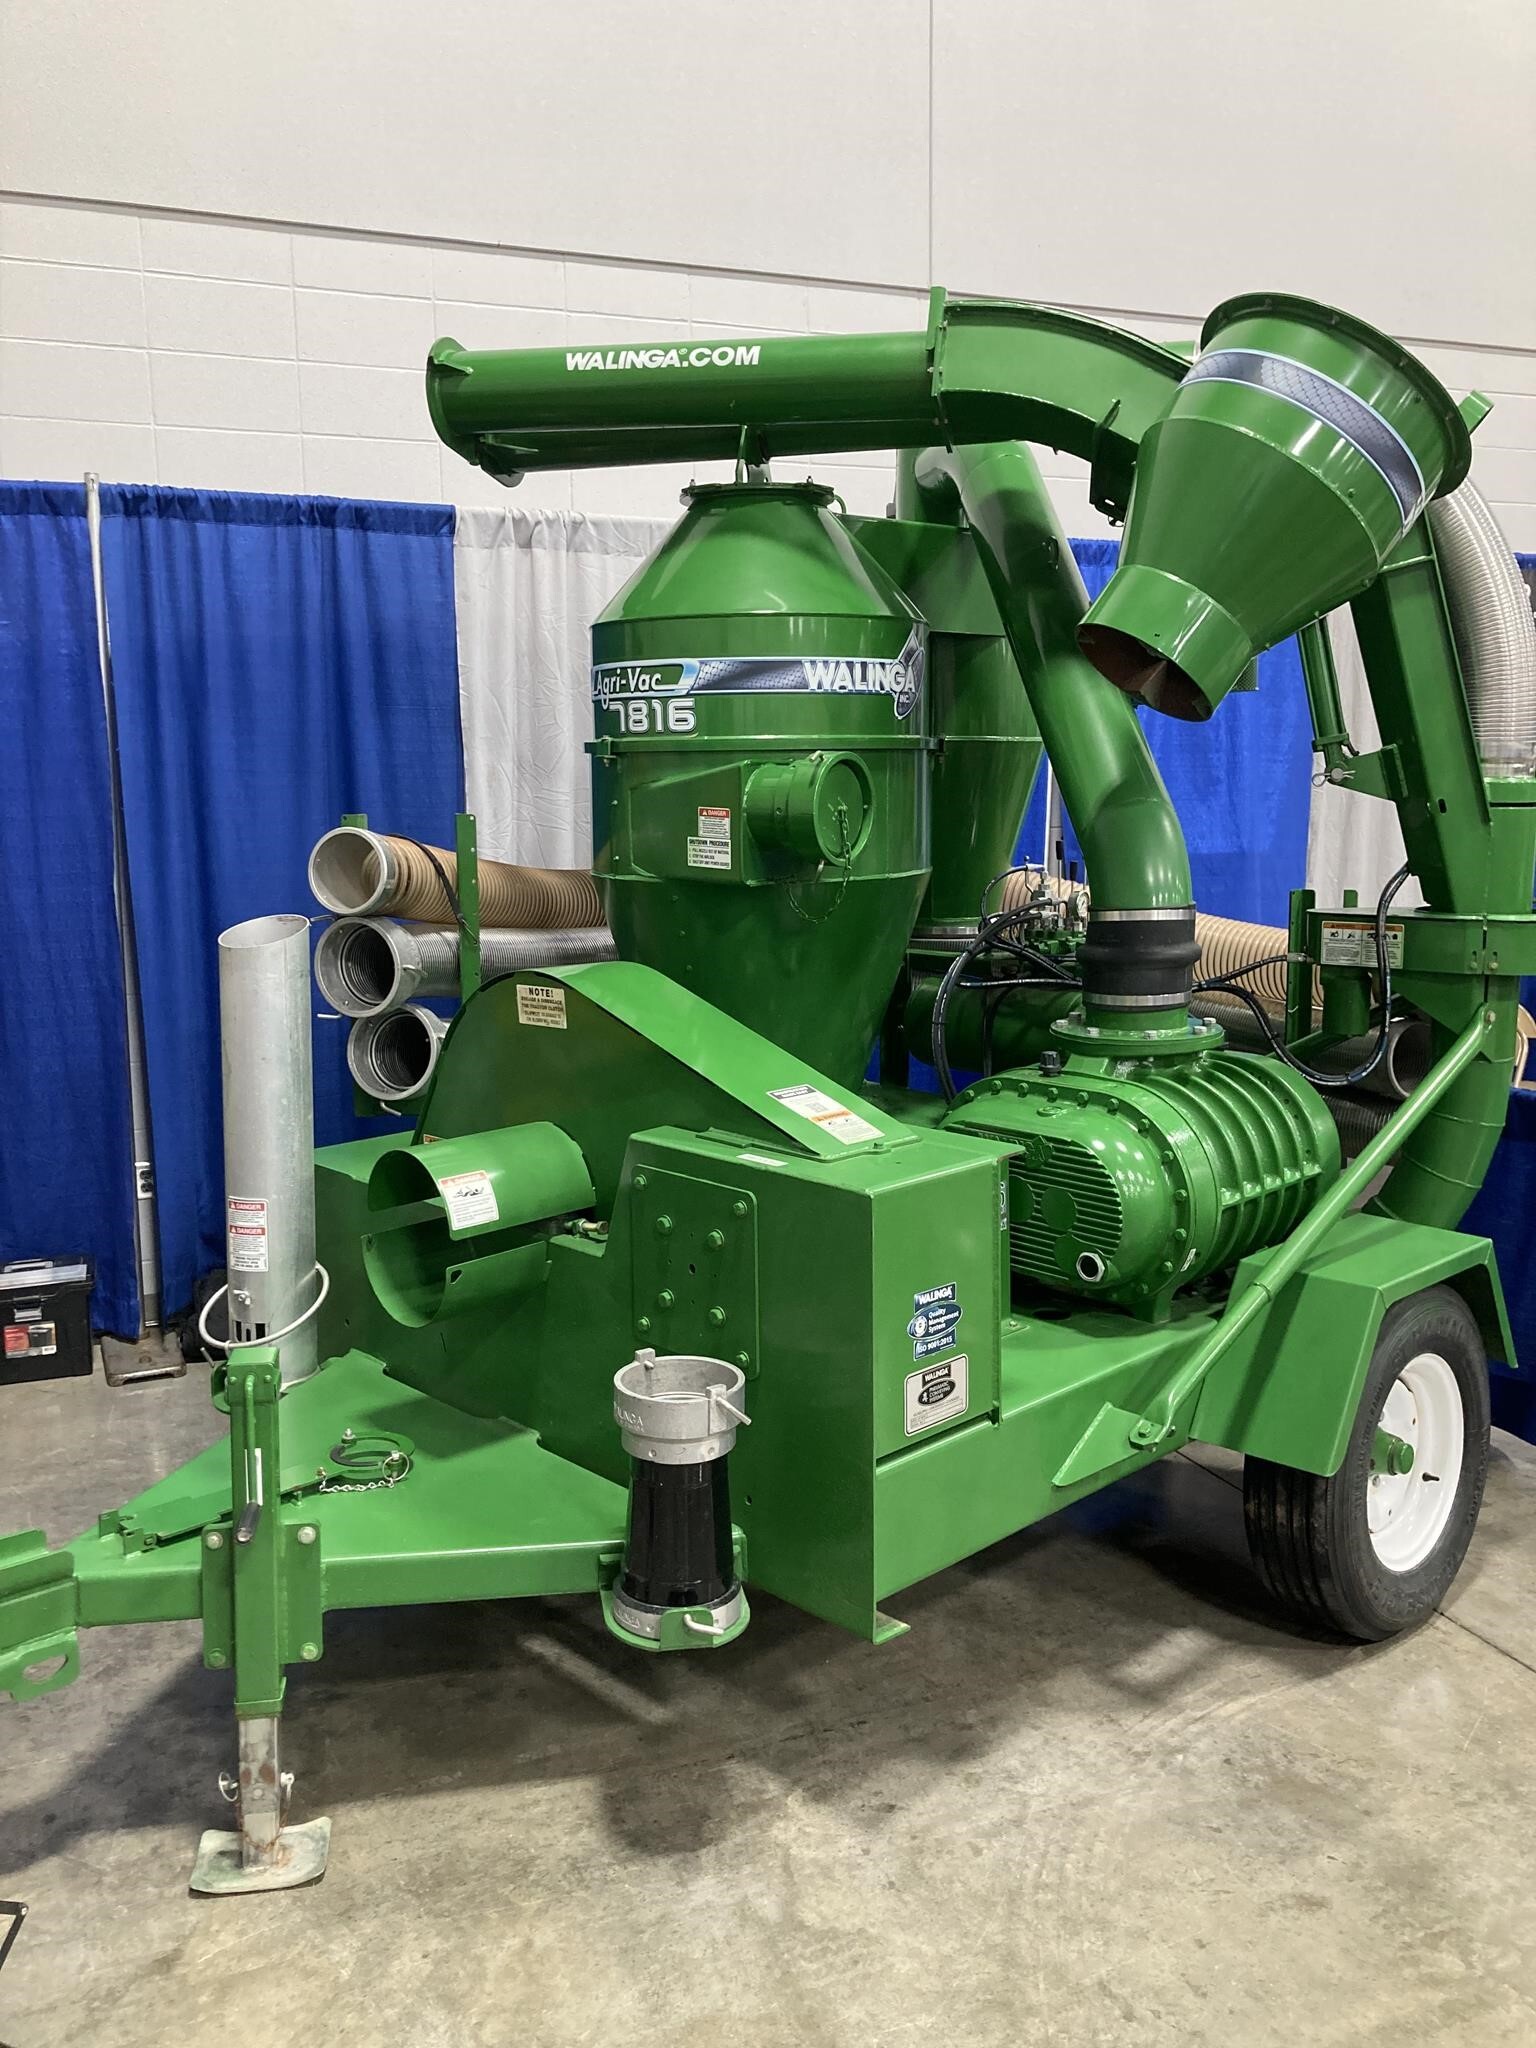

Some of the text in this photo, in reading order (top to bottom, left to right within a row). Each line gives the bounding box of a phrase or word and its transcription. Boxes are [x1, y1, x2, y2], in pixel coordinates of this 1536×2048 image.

[802, 660, 916, 692] WALINGA
[594, 667, 662, 710] Agri-Vac
[608, 698, 696, 733] 7816
[528, 987, 554, 998] NOTE!
[919, 1286, 953, 1304] WALINGA
[928, 1308, 946, 1319] Quality
[928, 1322, 946, 1333] System
